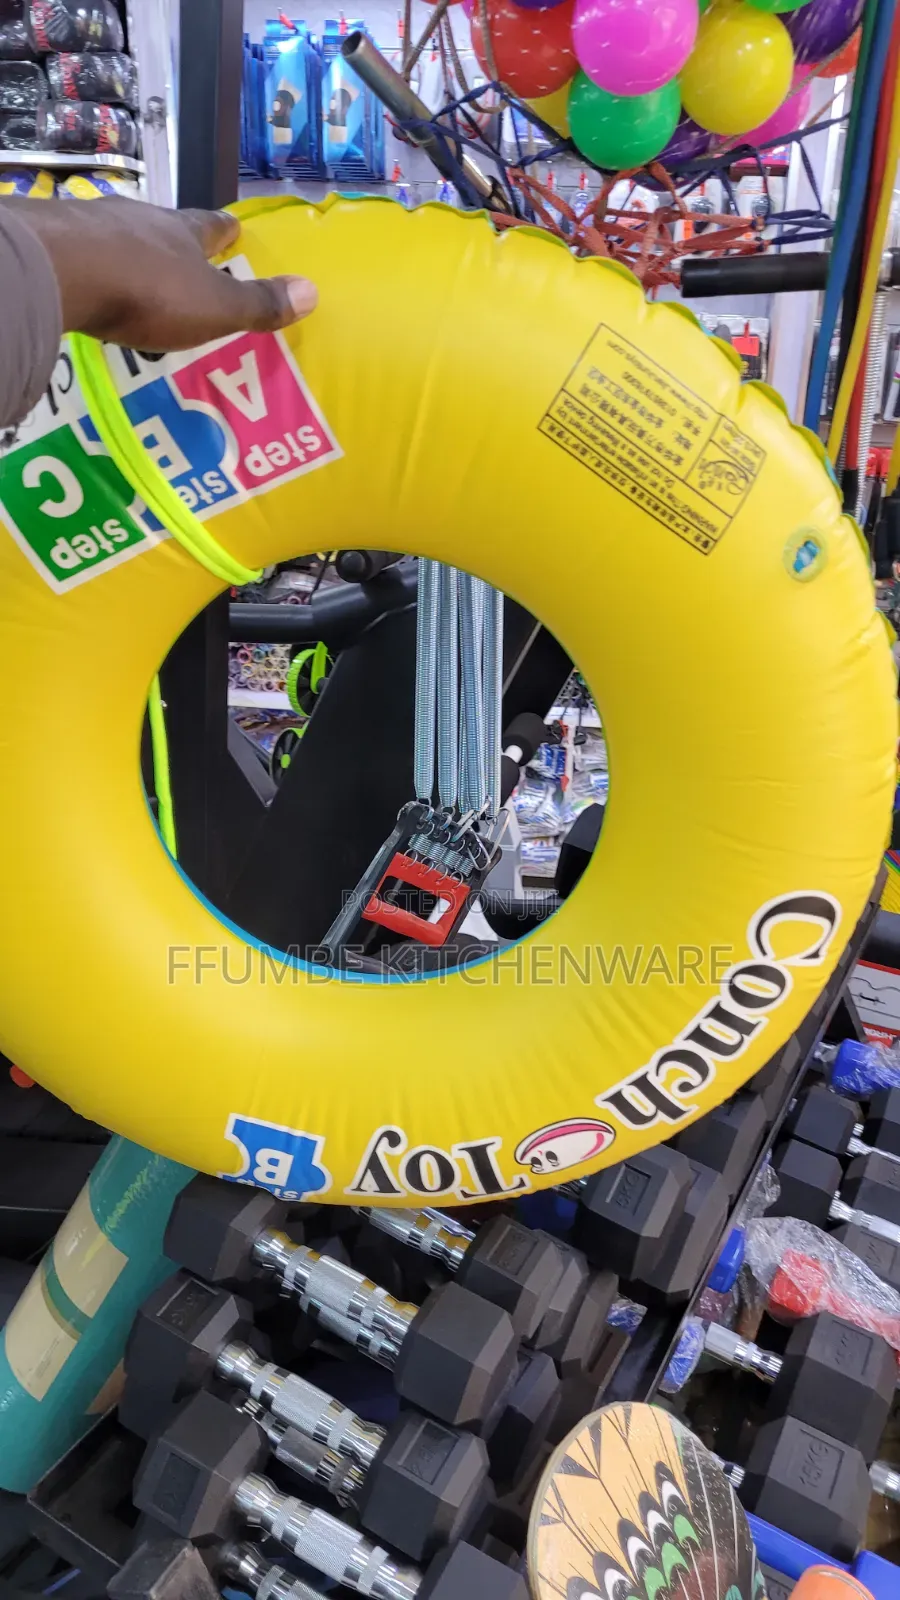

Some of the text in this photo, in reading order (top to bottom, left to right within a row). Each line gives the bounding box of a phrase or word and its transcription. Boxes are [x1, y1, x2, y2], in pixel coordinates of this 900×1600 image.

[206, 350, 269, 423] A
[244, 425, 322, 477] step
[22, 455, 84, 518] C
[176, 471, 228, 511] ste
[50, 518, 129, 570] step
[602, 894, 837, 1125] Conch
[253, 1148, 295, 1183] B
[351, 1129, 525, 1199] Toy
